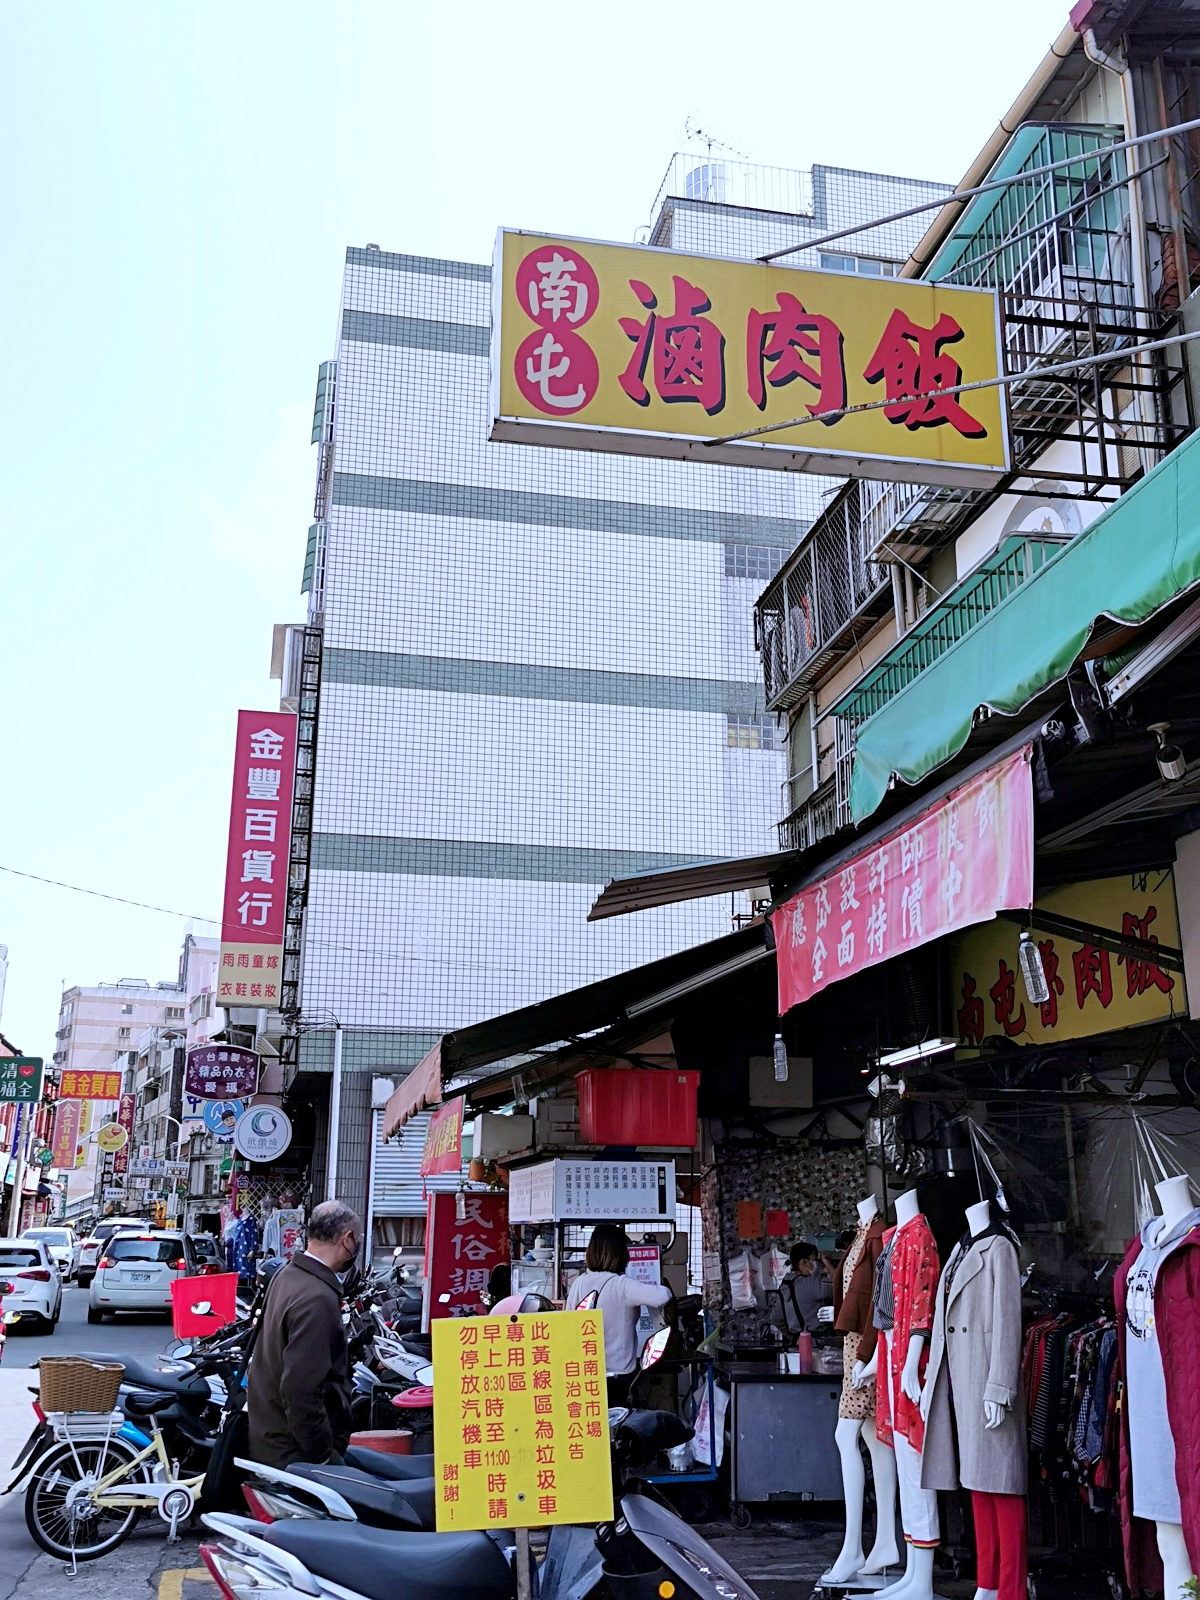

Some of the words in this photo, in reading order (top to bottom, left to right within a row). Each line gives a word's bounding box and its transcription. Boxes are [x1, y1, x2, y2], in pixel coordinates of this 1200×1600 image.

[526, 252, 588, 409] 南屯
[617, 274, 988, 440] 滷肉飯
[237, 728, 284, 926] 金豐百貨行
[811, 861, 963, 983] 全面特價中
[1, 1063, 18, 1078] 清
[62, 1073, 120, 1096] 黃金買賣
[199, 1065, 245, 1078] 精品內衣
[206, 1052, 240, 1062] 台灣製
[459, 1326, 483, 1470] 勿停放汽機車
[505, 1323, 527, 1392] 專用區
[565, 1360, 584, 1460] 自治會公告
[580, 1319, 602, 1438] 公有南屯市場
[531, 1321, 558, 1516] 此黃線區為垃圾車
